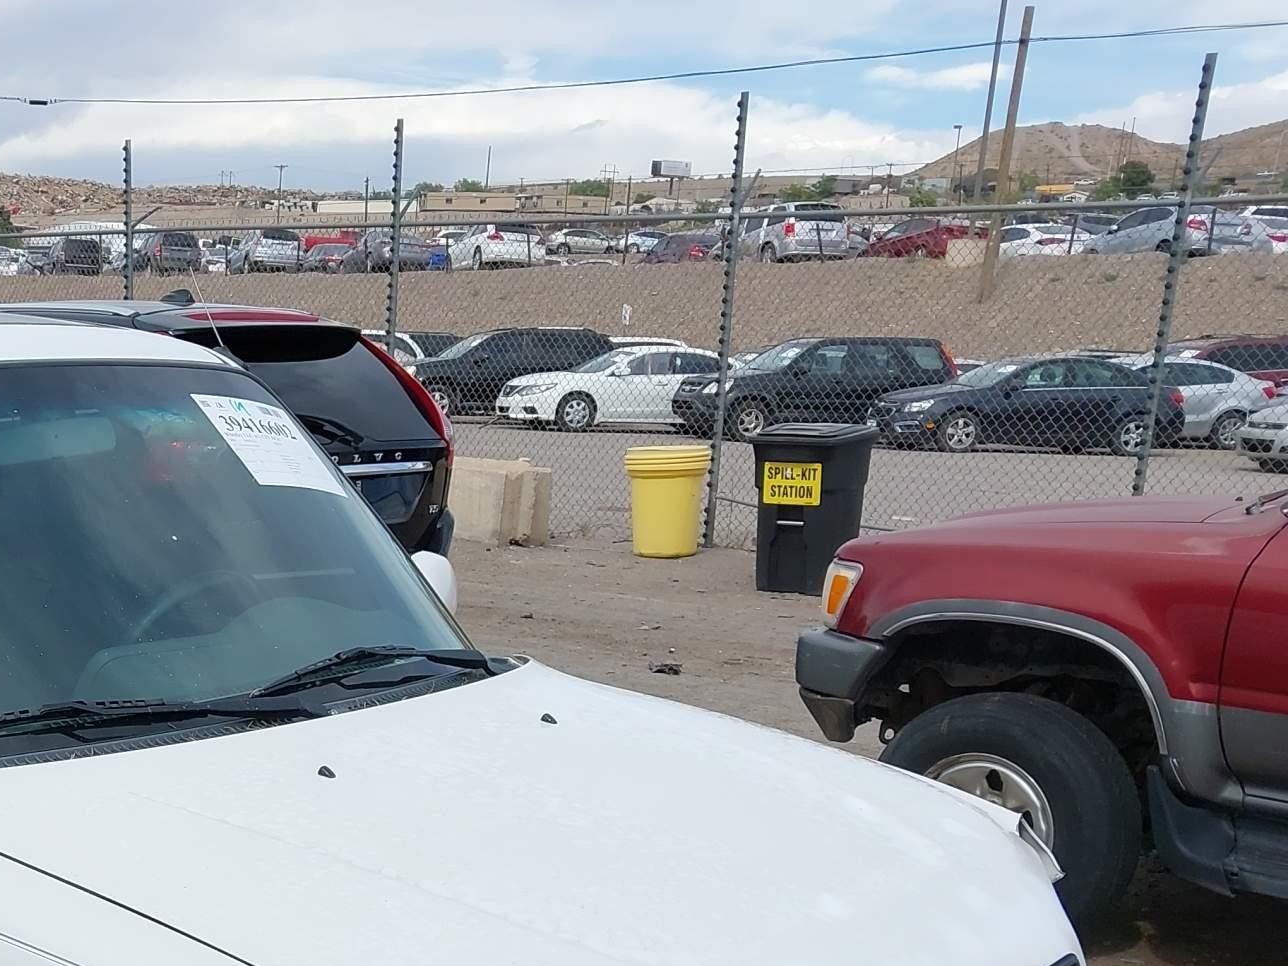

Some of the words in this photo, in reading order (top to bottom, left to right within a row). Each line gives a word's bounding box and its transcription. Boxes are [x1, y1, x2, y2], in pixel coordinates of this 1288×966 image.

[219, 414, 297, 440] 39416602
[331, 452, 403, 463] OLVO
[767, 466, 819, 481] SPILL-KIT
[770, 484, 813, 499] STATION
